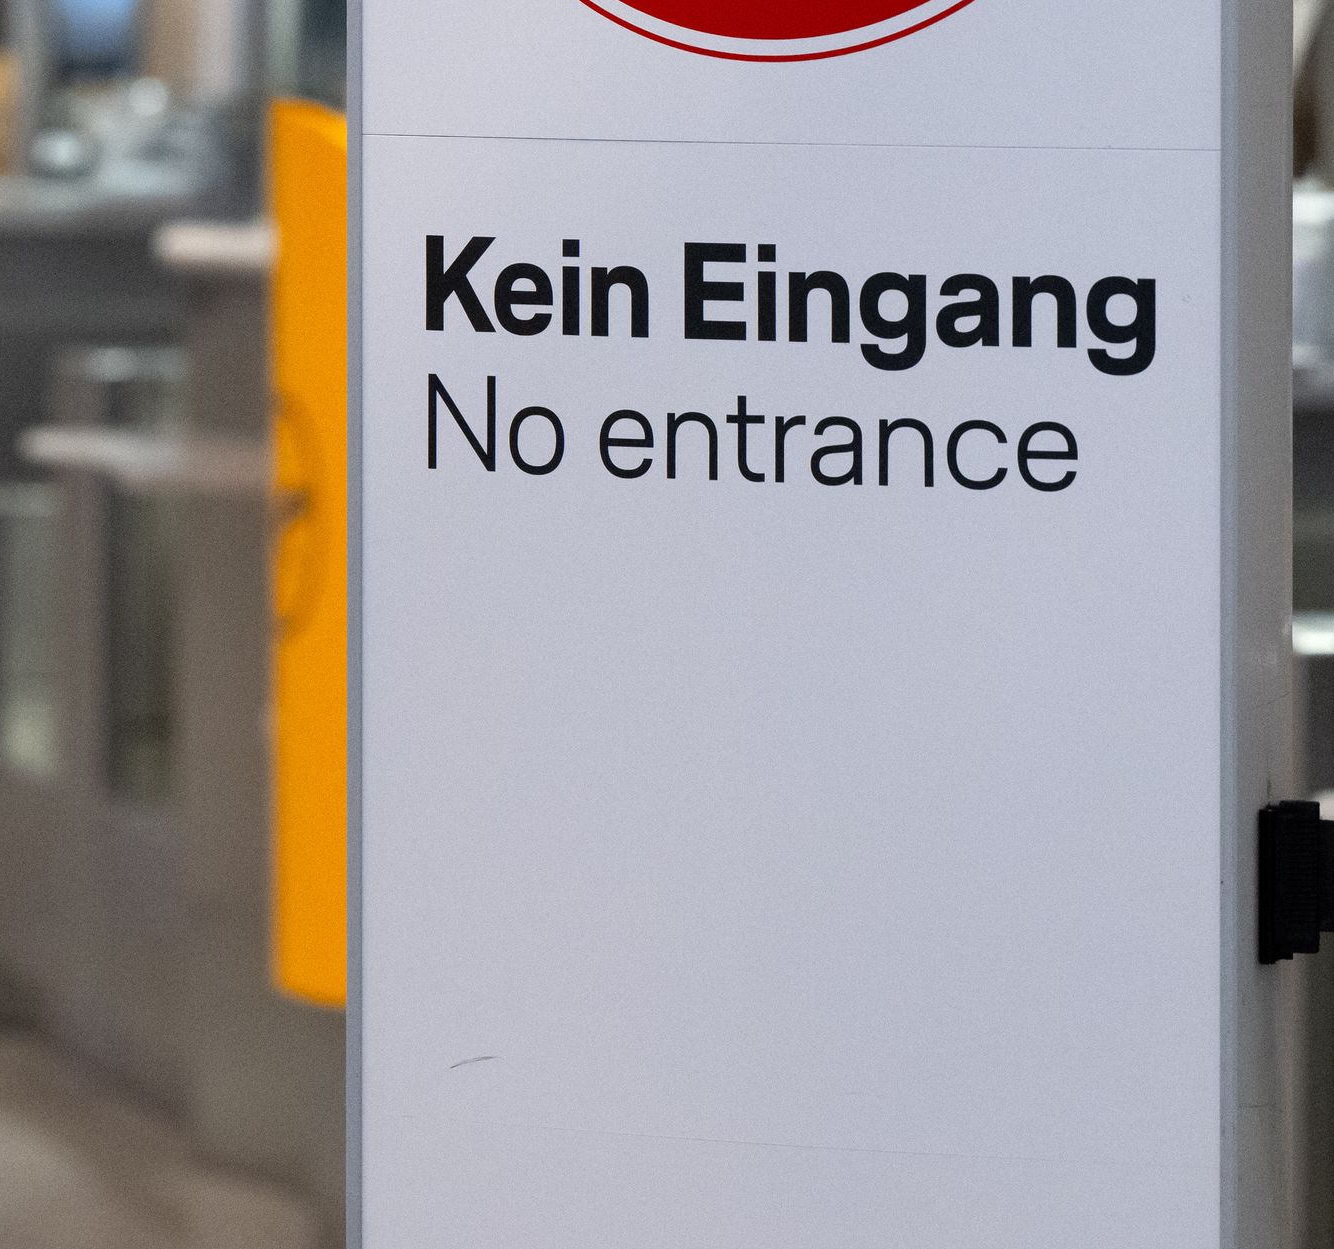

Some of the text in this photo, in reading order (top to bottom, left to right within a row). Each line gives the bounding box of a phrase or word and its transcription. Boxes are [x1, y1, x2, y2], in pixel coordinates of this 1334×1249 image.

[425, 235, 1157, 377] Kein Eingang
[427, 373, 1079, 493] No entrance
